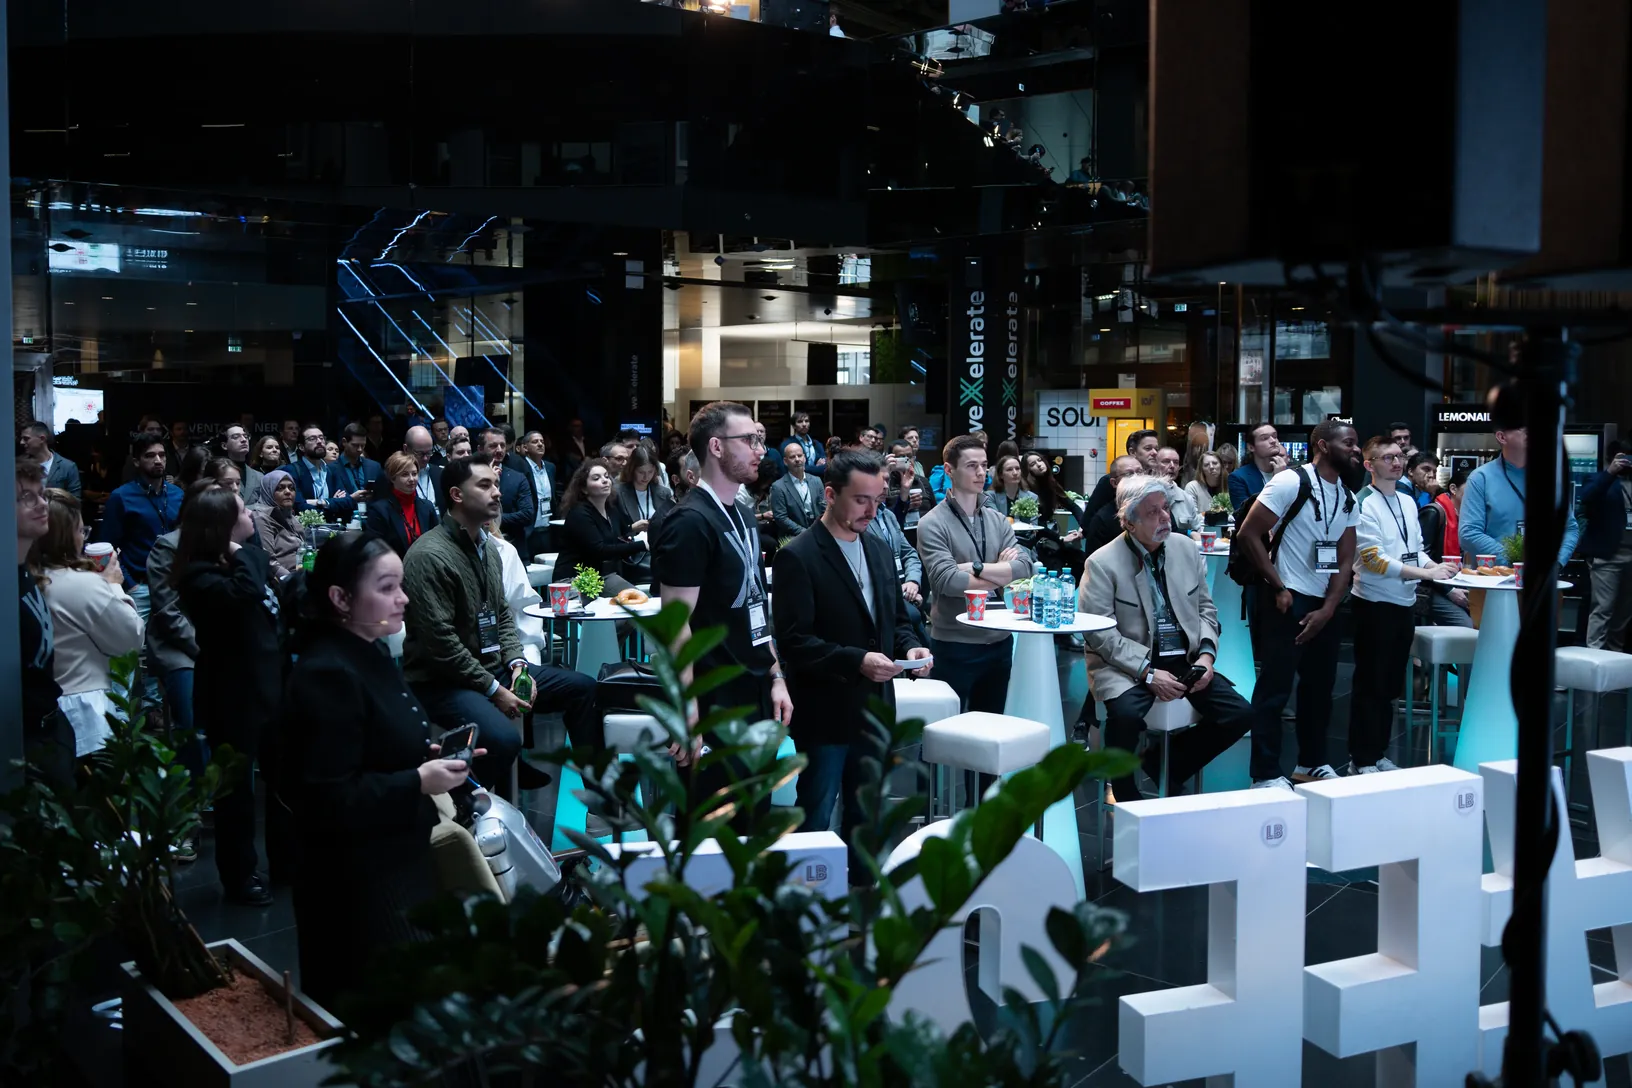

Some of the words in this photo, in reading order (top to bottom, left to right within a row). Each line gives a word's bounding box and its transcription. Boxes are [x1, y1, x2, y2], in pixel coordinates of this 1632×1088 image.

[1458, 793, 1475, 809] LB
[1266, 824, 1283, 840] LB
[806, 864, 828, 882] LB
